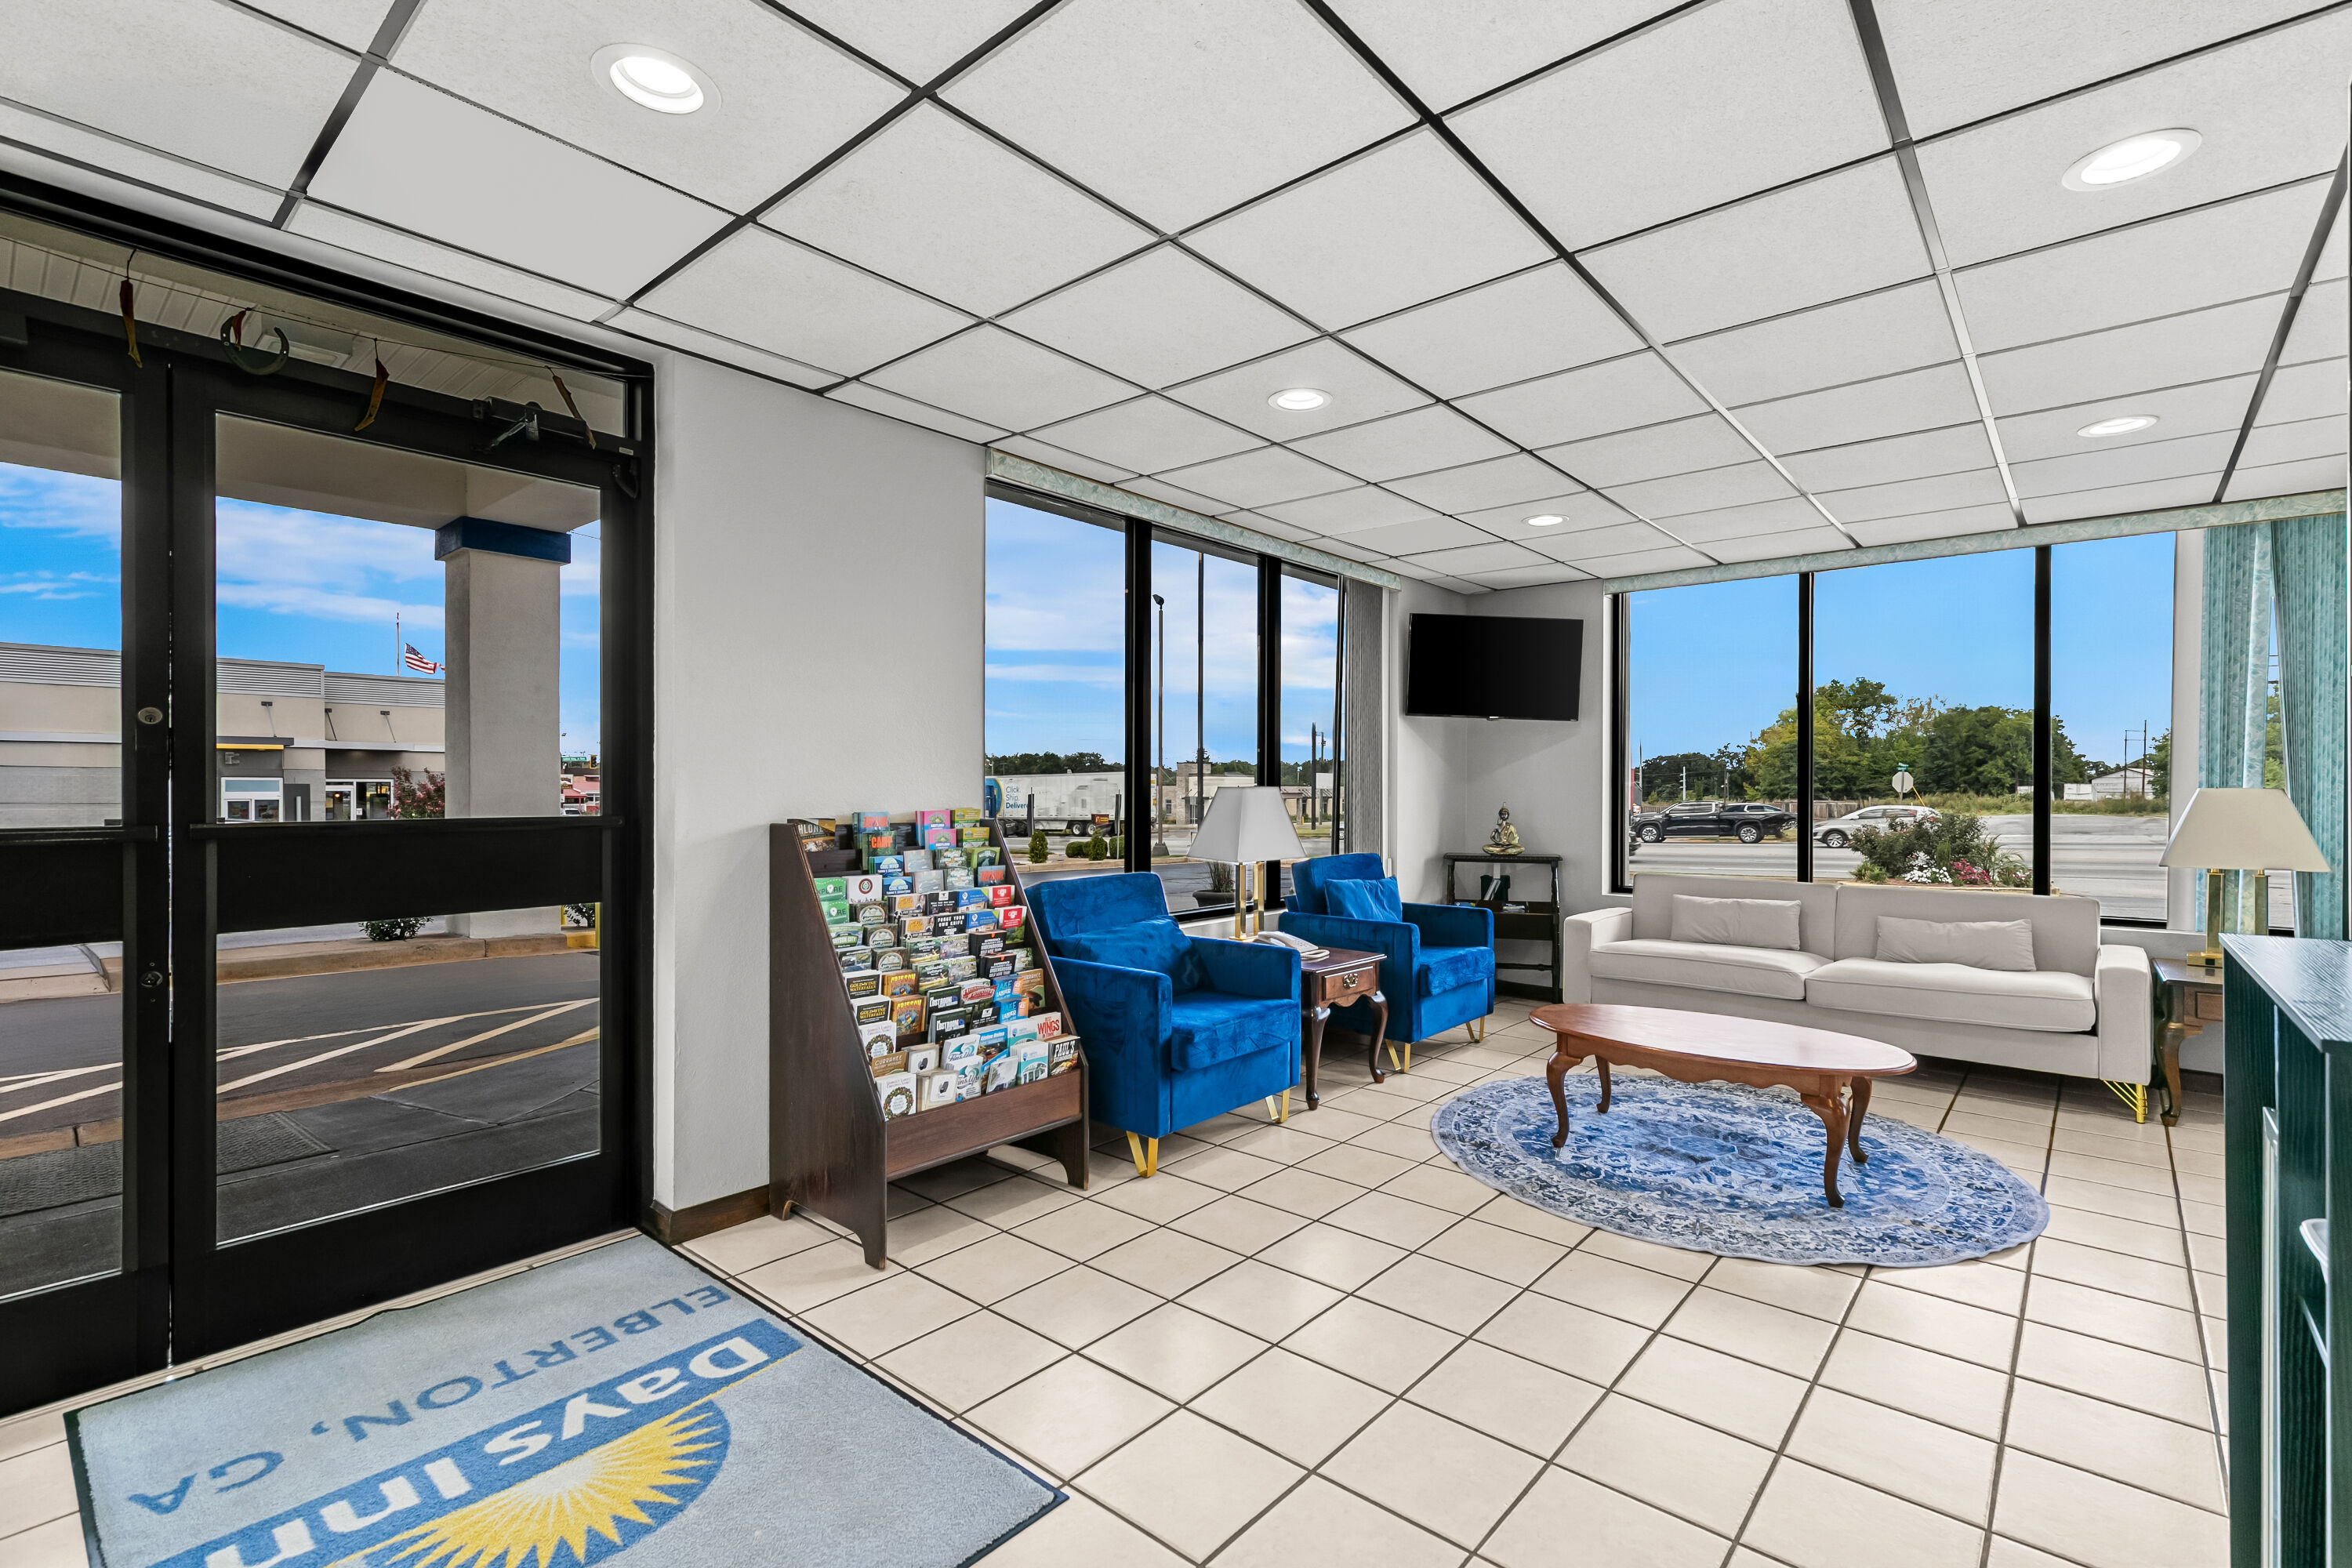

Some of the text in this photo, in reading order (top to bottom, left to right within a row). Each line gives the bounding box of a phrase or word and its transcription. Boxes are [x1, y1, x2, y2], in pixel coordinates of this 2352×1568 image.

[871, 837, 892, 848] CAMP
[1037, 1019, 1060, 1035] WINGS
[1054, 1040, 1075, 1057] PAUL'S
[125, 1284, 733, 1515] ELBERTON, GA
[205, 1336, 770, 1568] Days Inn
